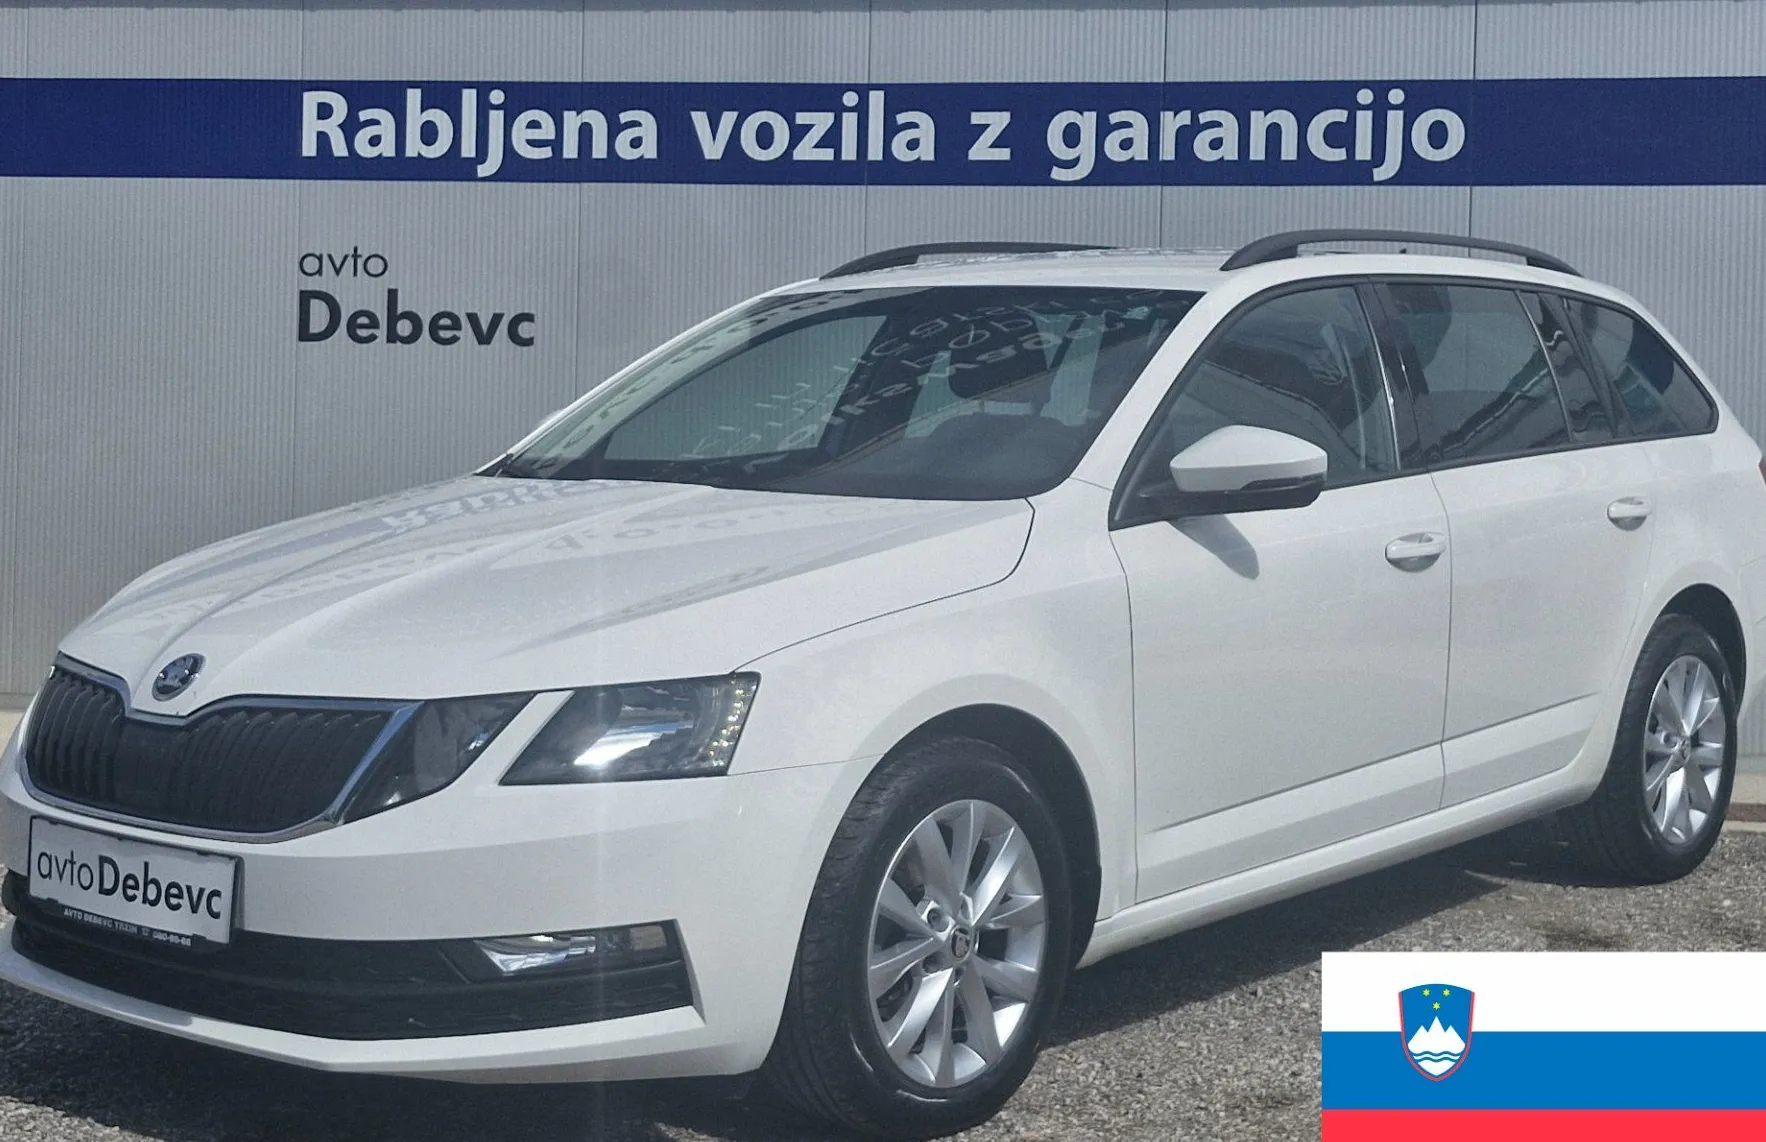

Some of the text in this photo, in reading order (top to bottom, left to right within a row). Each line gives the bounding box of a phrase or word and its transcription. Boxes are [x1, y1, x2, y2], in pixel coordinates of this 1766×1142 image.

[300, 88, 1466, 182] Rabljena vozila z garancijo
[298, 246, 388, 278] avto
[297, 288, 536, 348] Debevc
[63, 906, 83, 921] AVTO
[83, 911, 113, 929] DEBEVC
